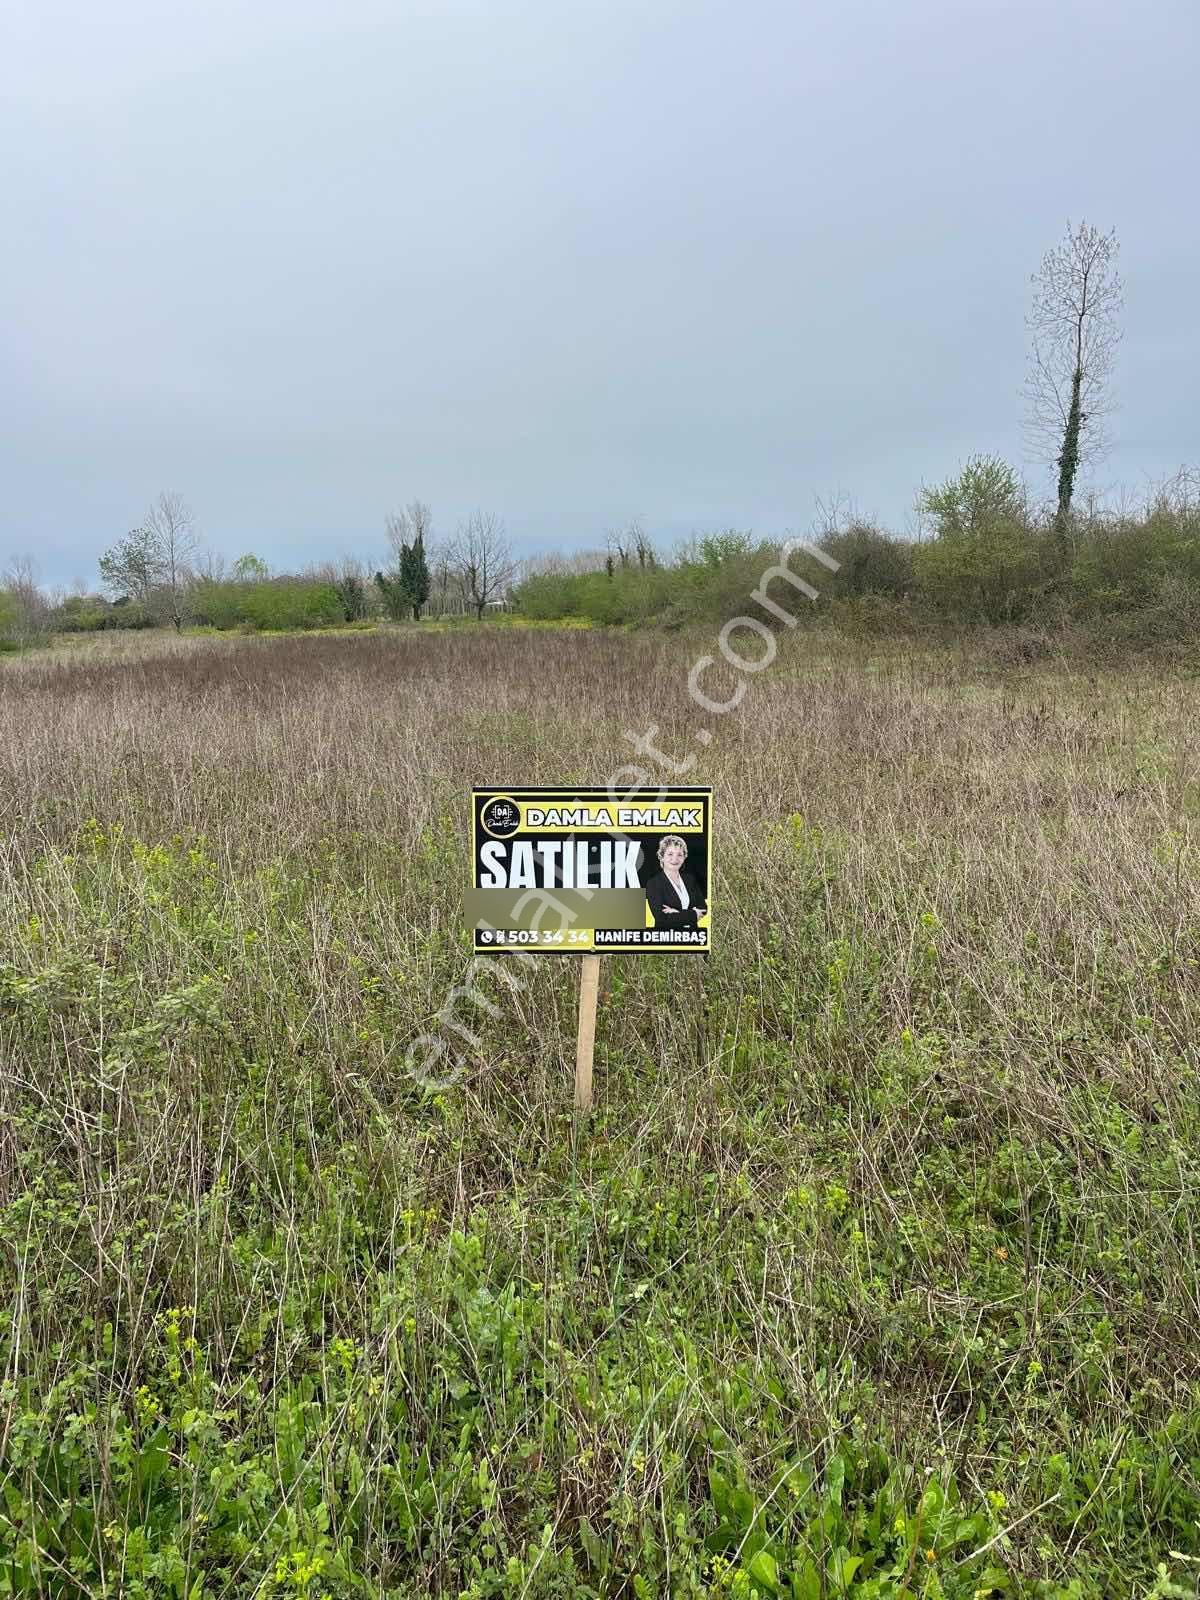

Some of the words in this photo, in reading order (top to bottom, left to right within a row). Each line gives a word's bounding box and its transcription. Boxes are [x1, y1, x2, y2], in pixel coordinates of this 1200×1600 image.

[496, 807, 508, 817] DA
[526, 809, 613, 827] DAMLA
[618, 809, 701, 827] EMLAK
[480, 840, 642, 888] SATILIK
[508, 930, 539, 943] 503
[543, 930, 564, 943] 34
[567, 930, 590, 943] 34
[595, 929, 641, 943] HANİFE
[643, 929, 707, 946] DEMİRBAŞ
